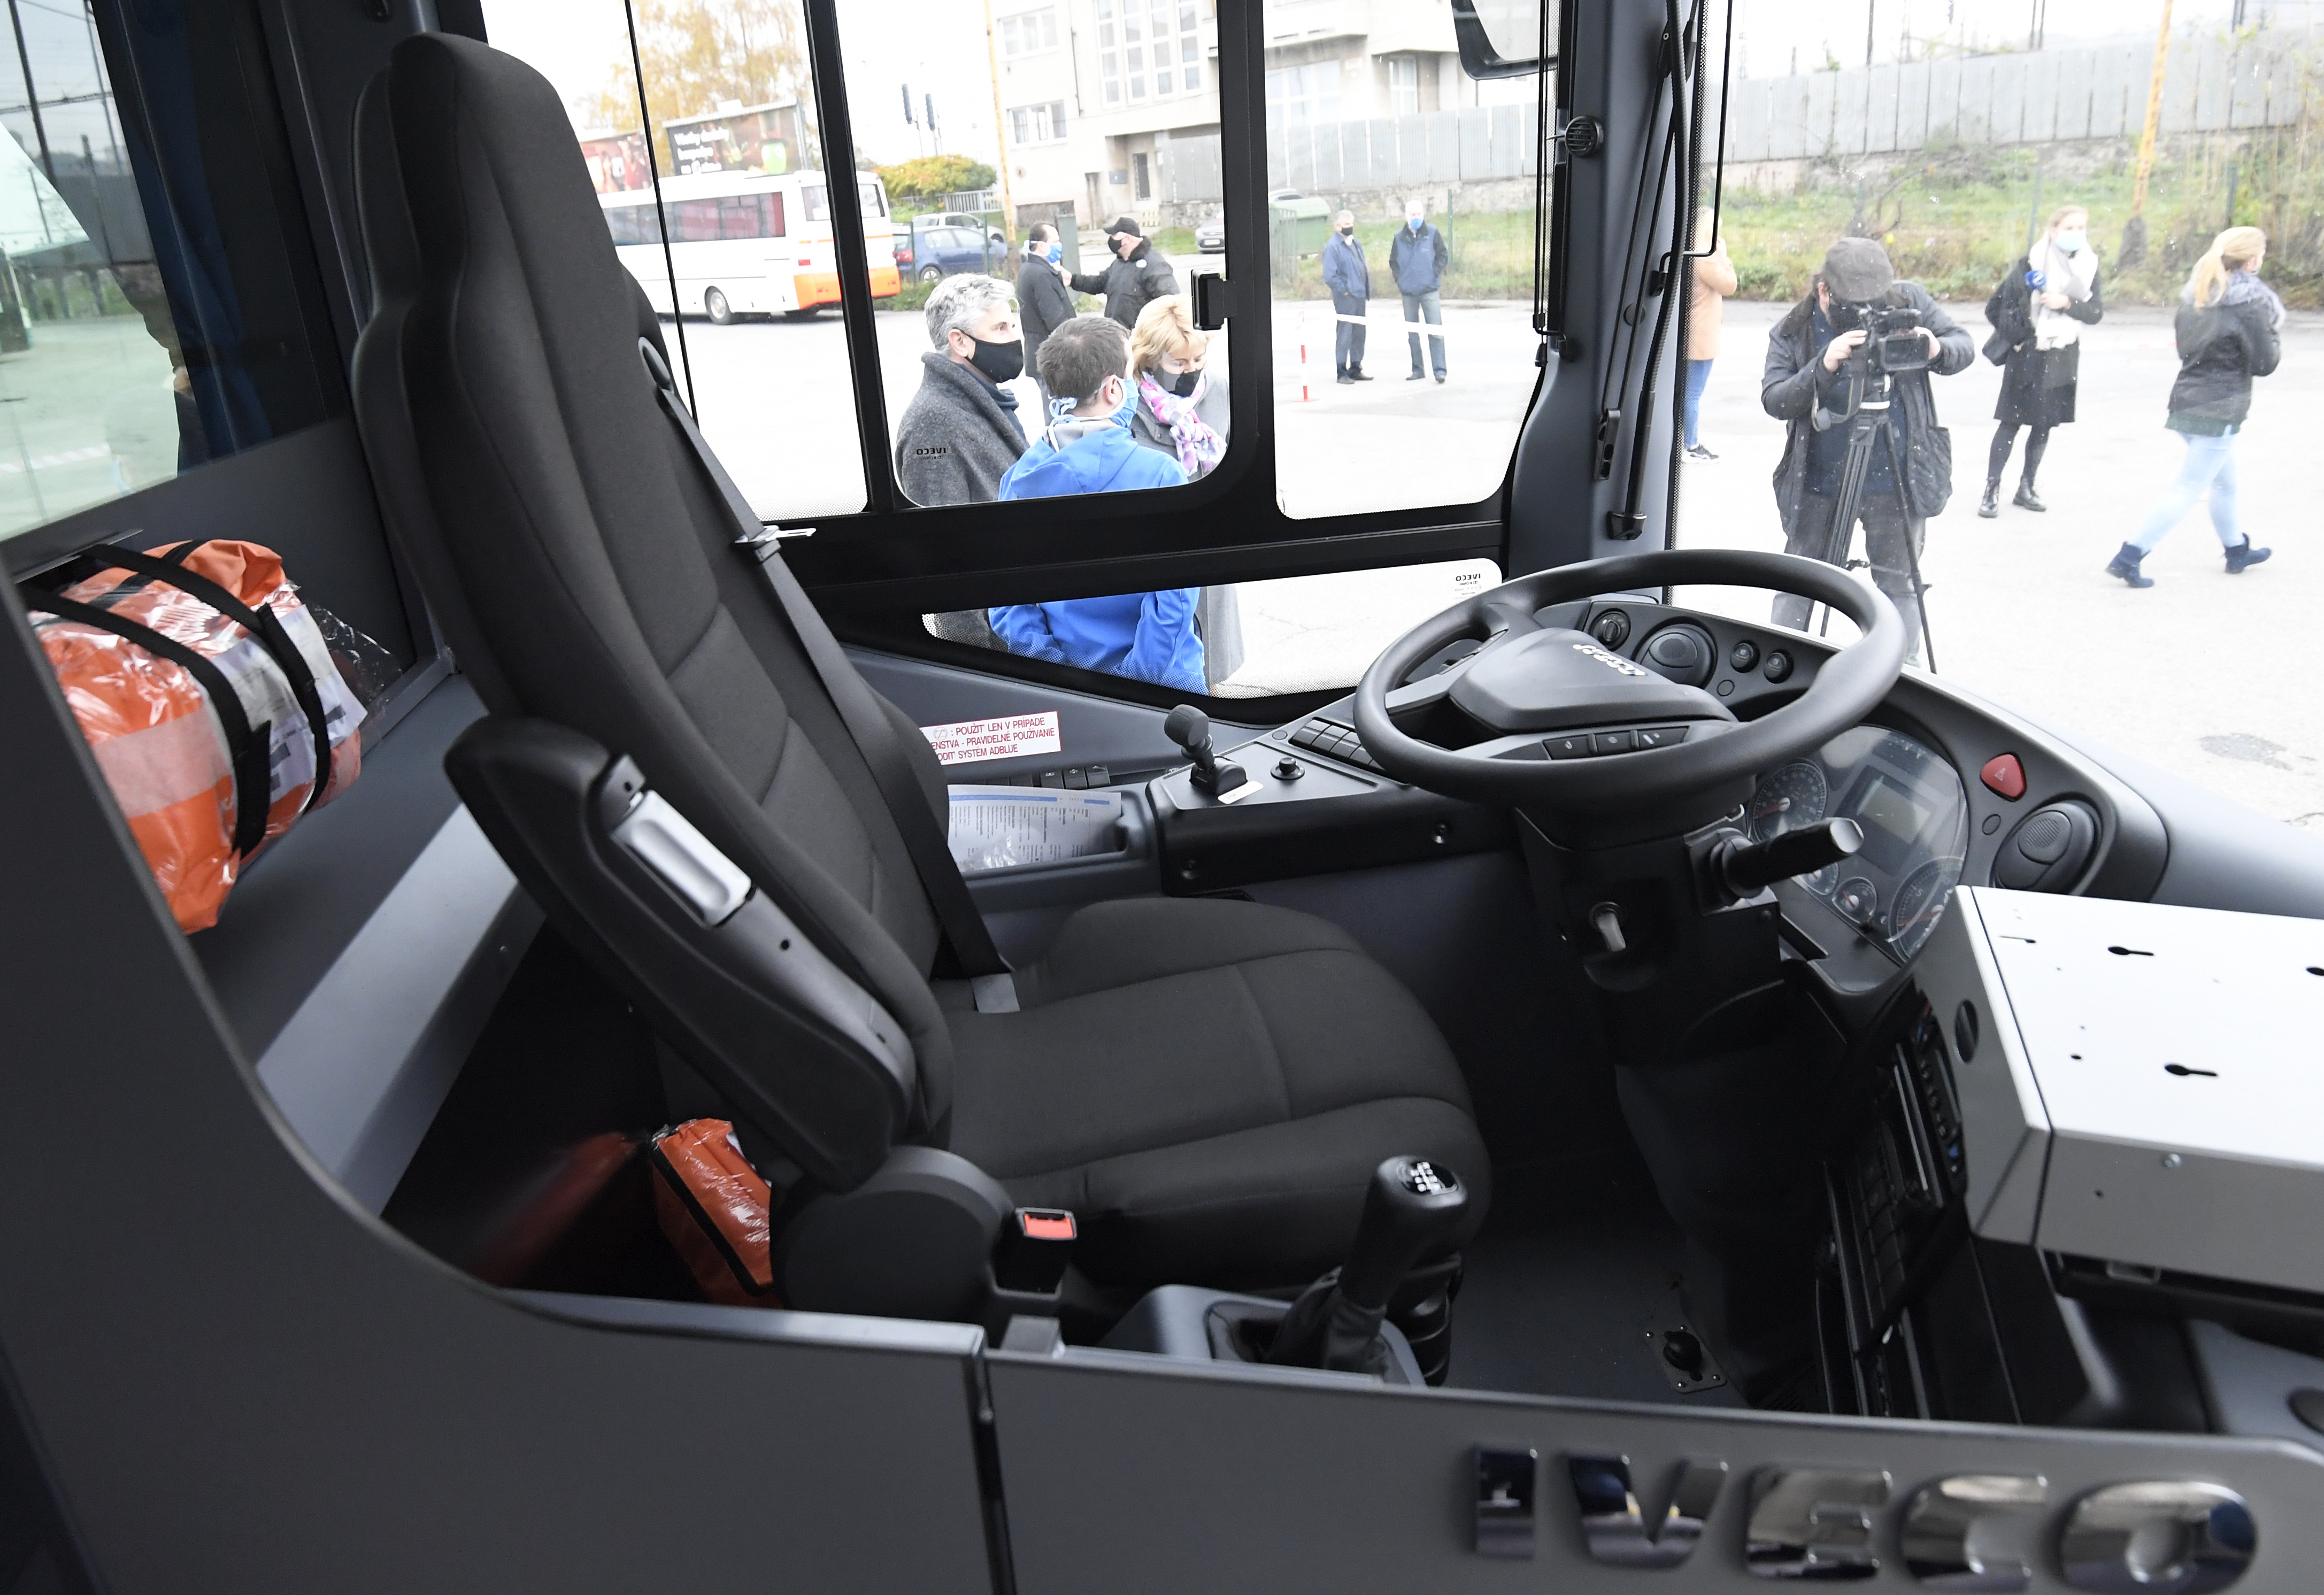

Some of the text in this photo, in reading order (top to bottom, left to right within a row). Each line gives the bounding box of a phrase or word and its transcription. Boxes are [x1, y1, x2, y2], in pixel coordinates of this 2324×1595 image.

[988, 722, 1003, 732] LEN
[1005, 721, 1010, 730] V
[1013, 717, 1045, 729] PRÍPADE
[966, 730, 1011, 746] PRAVIDELNÉ
[1013, 727, 1055, 741] POUŽÍVANIE
[958, 745, 987, 759] SYSTÉM
[990, 744, 1018, 756] ADBLUE
[1475, 1447, 2258, 1595] IVECO
